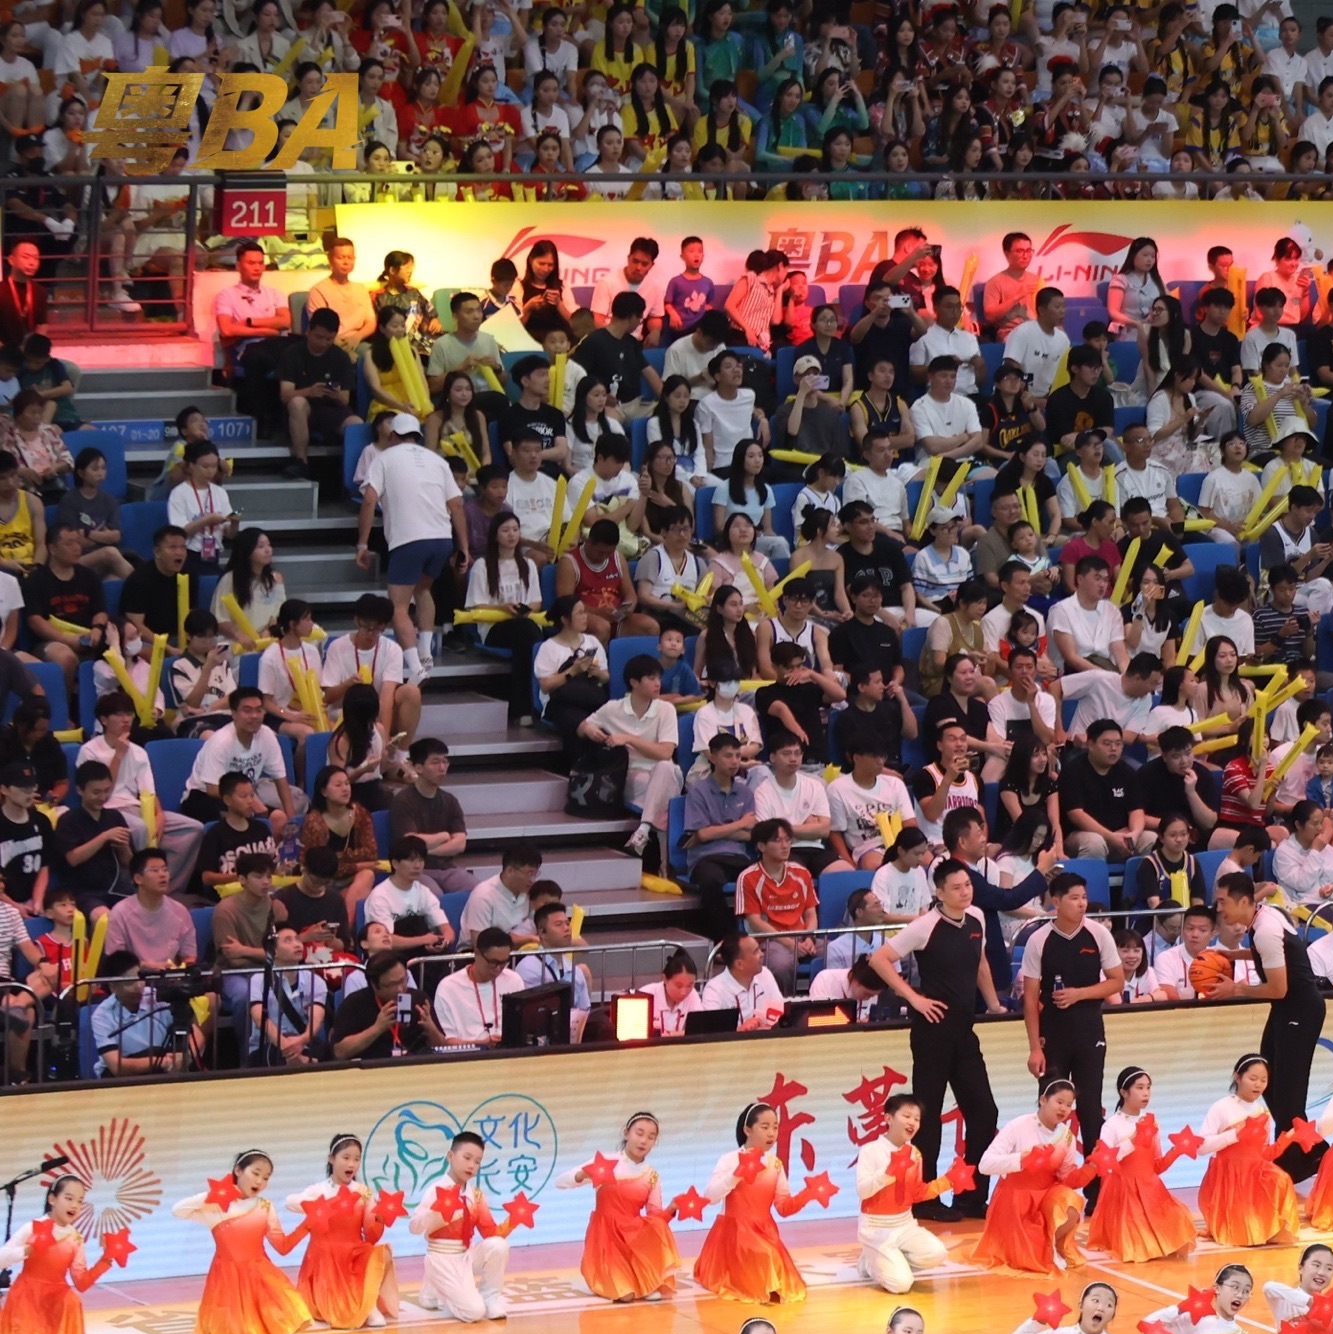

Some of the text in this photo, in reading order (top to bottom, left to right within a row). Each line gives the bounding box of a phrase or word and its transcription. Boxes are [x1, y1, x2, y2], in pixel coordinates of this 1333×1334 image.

[81, 65, 362, 175] 粤BA
[231, 200, 278, 228] 211
[1037, 264, 1119, 282] LI-NIN
[218, 421, 243, 438] 107
[946, 795, 979, 810] ARRIORS
[473, 1111, 542, 1160] 文化
[475, 1154, 537, 1193] 长安
